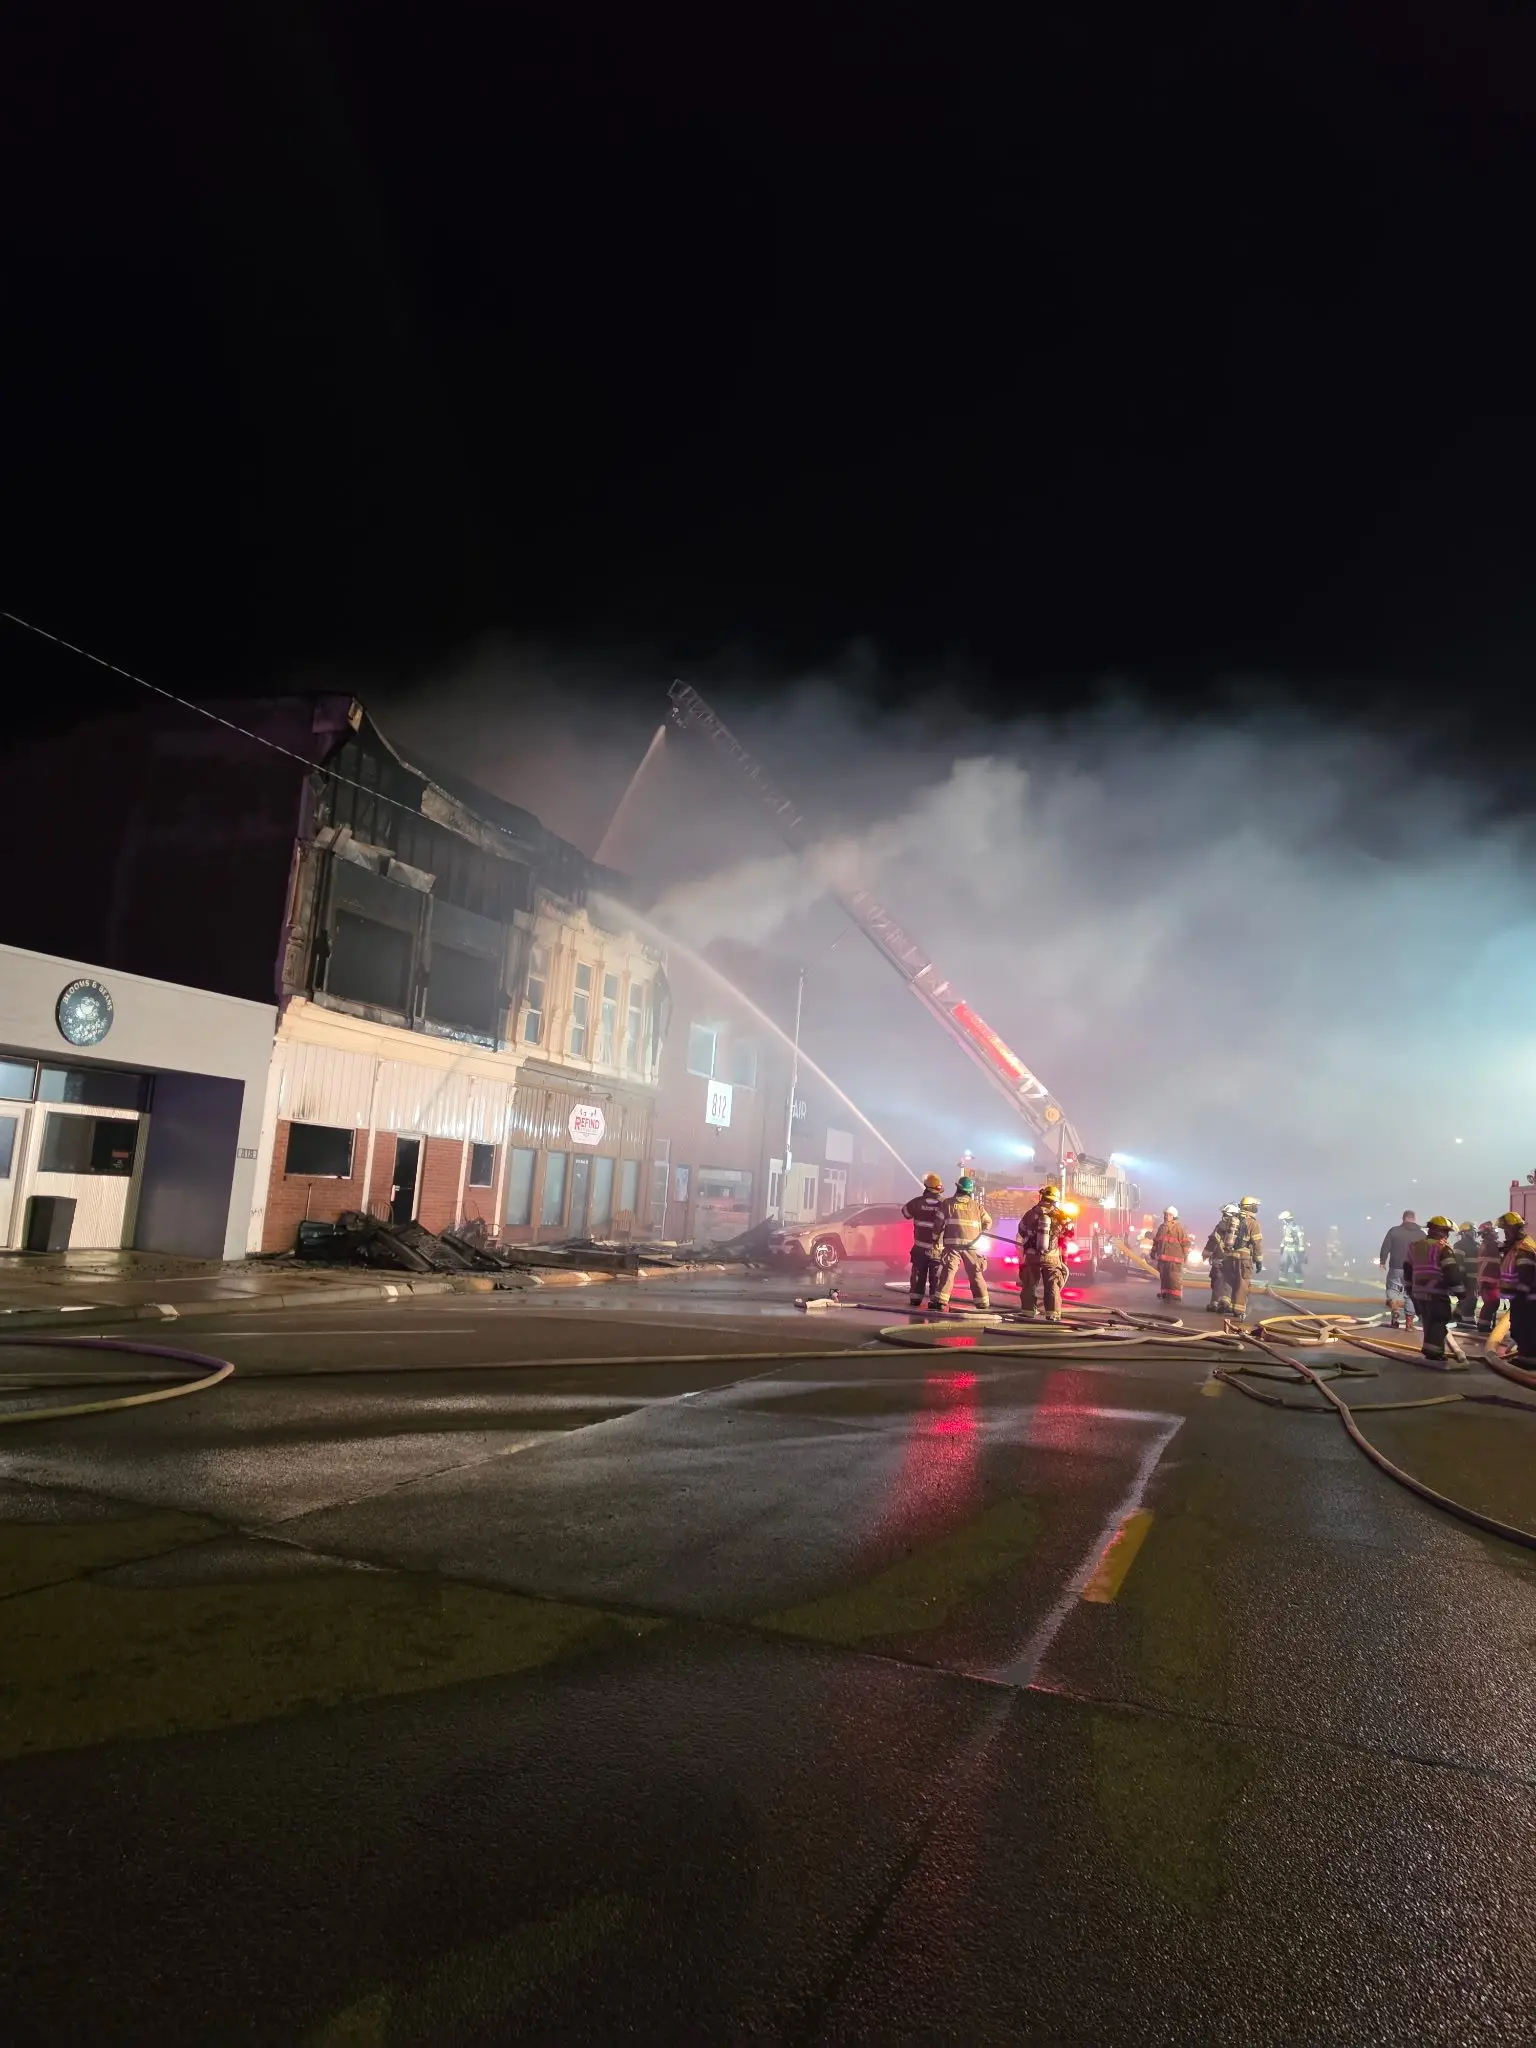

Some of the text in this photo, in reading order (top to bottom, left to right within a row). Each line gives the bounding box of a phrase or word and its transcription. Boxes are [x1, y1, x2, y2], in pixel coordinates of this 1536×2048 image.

[63, 980, 89, 1004] BLOOMS
[99, 985, 112, 1011] BEANS
[712, 1094, 726, 1118] 812
[575, 1116, 599, 1130] REFIND
